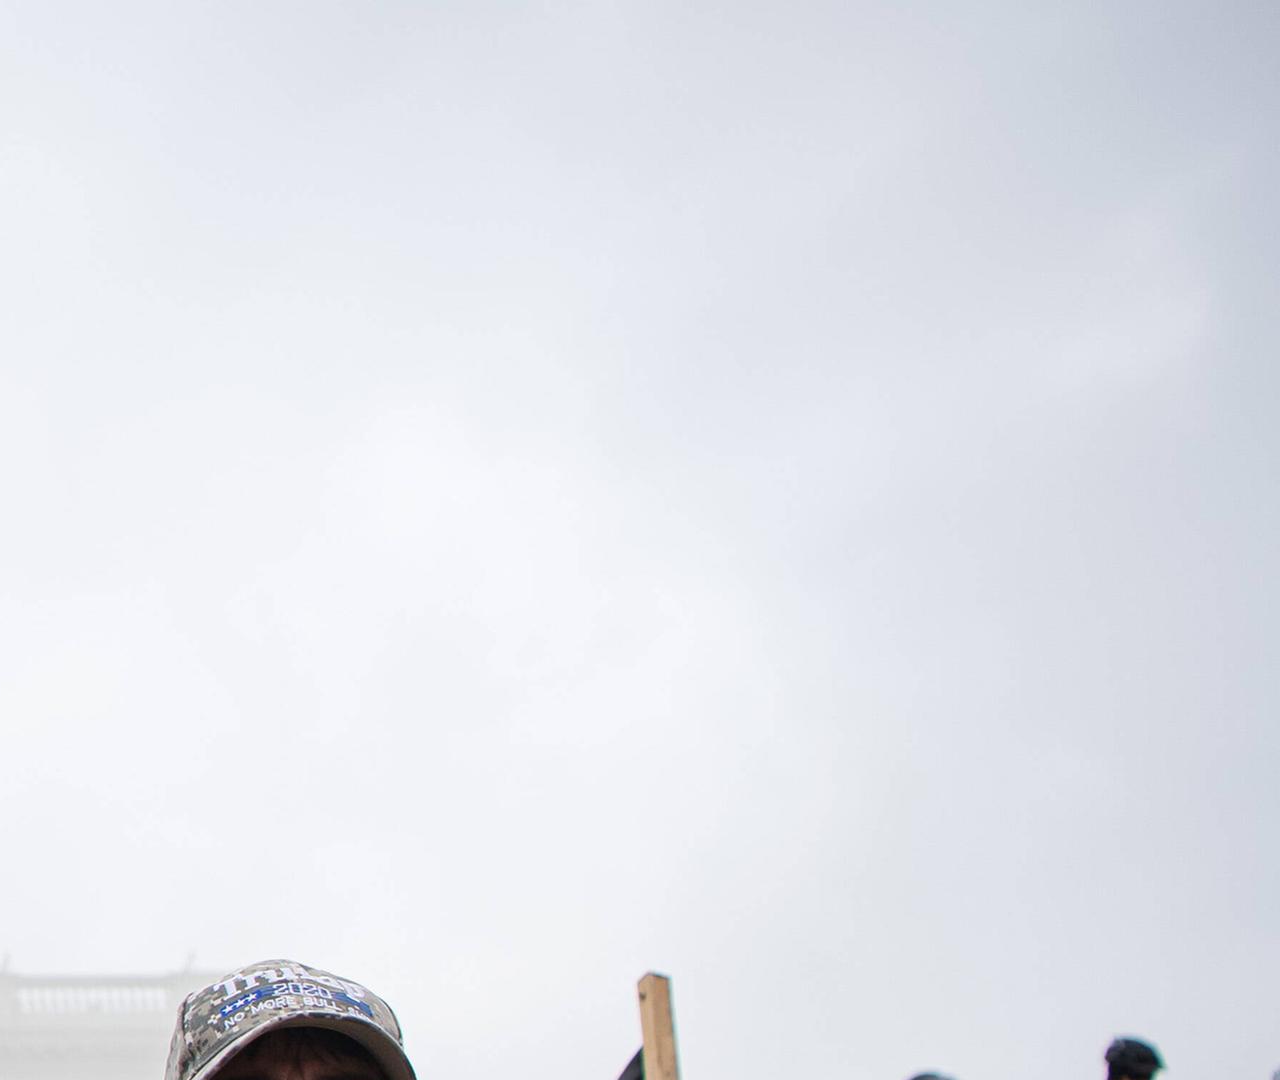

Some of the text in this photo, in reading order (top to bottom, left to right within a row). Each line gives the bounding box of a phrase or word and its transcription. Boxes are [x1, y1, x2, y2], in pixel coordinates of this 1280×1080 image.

[272, 983, 333, 999] 2020
[224, 1012, 246, 1029] NO
[250, 996, 298, 1014] MORE
[303, 998, 342, 1011] BULL
